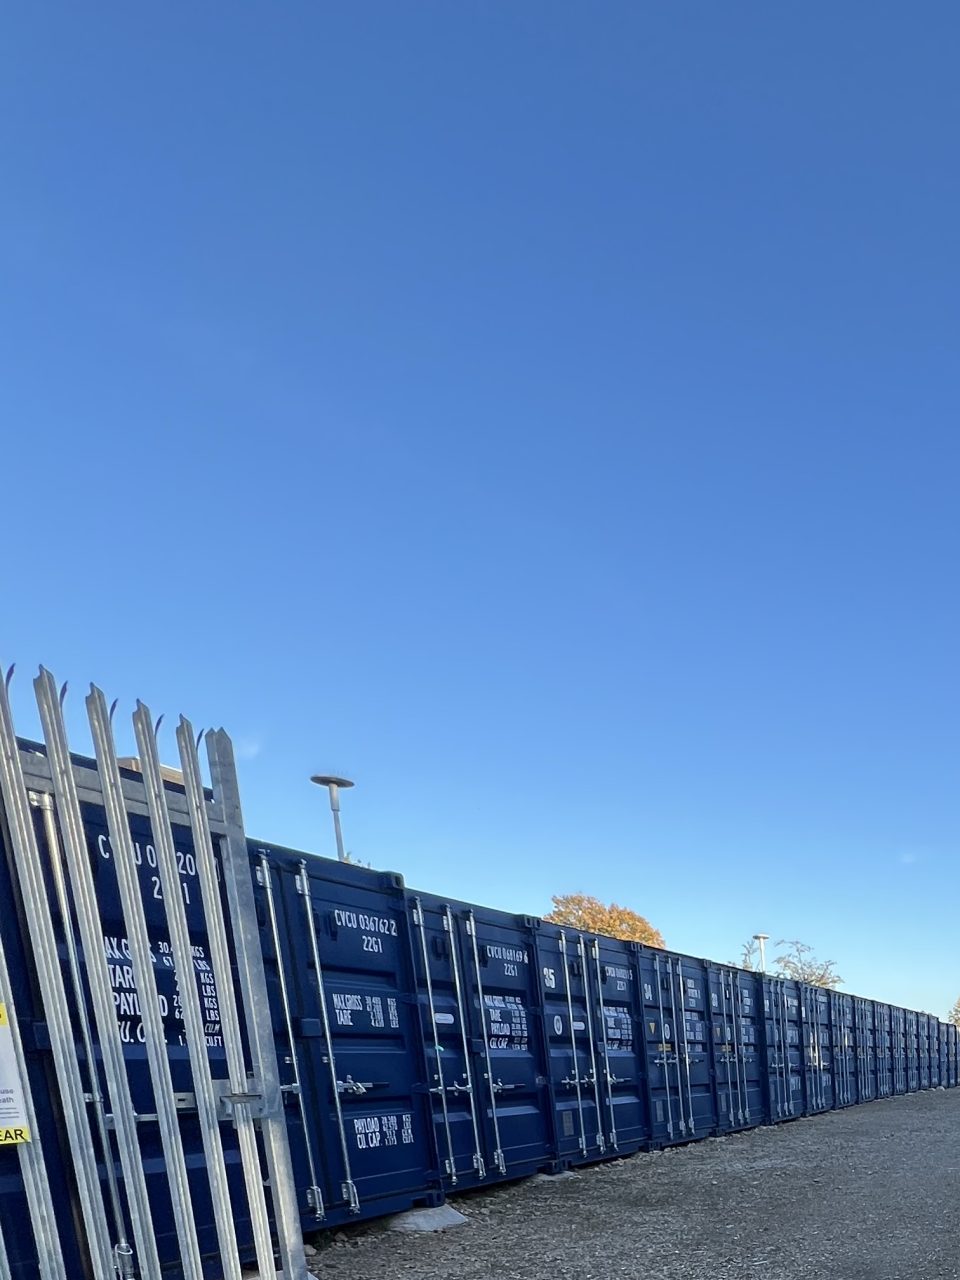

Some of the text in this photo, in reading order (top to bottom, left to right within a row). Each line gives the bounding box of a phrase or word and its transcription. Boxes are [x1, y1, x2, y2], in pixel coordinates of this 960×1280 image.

[334, 909, 358, 929] CVCU
[358, 914, 390, 935] 036762
[104, 936, 125, 960] AX
[361, 935, 383, 953] 22G1
[107, 964, 135, 989] TAR
[543, 967, 556, 989] 35
[202, 985, 216, 997] LBS
[206, 1010, 220, 1021] LBS
